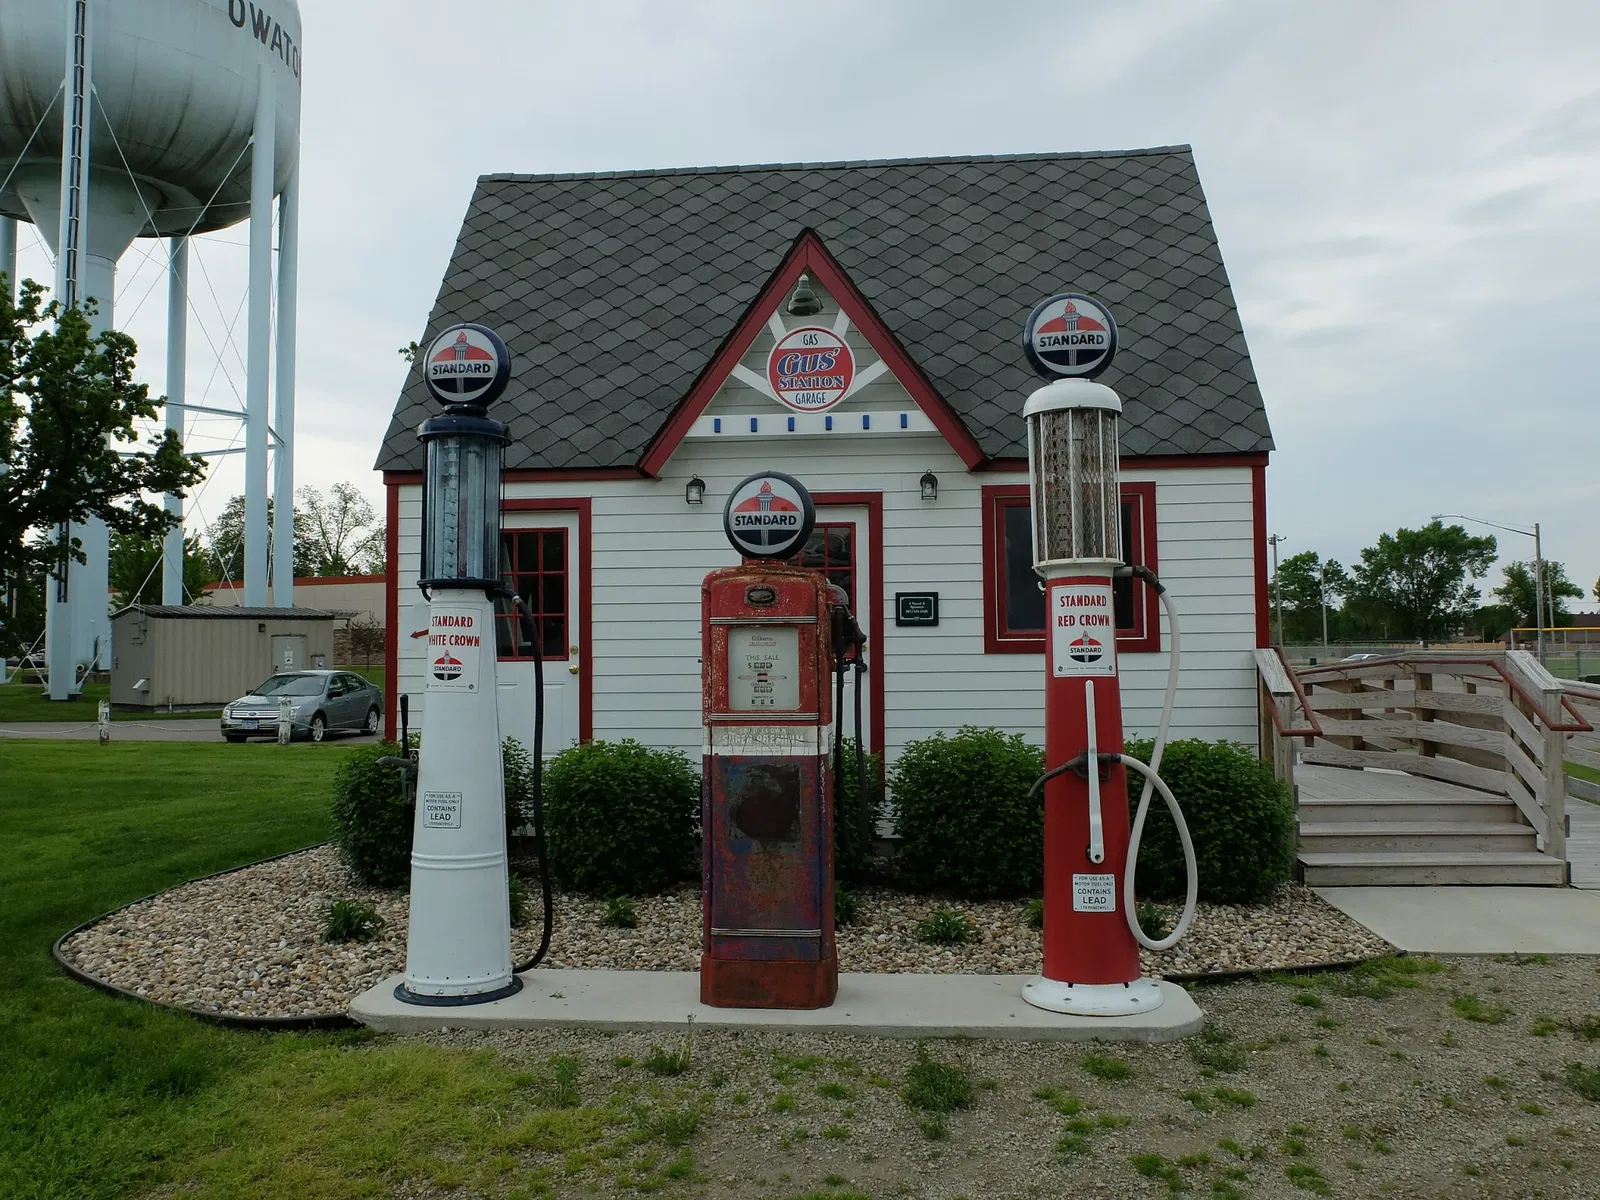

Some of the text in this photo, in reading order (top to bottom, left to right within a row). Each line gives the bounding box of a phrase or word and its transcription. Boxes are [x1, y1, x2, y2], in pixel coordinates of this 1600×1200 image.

[229, 0, 301, 86] OWATO
[803, 334, 818, 346] GAS
[1039, 334, 1104, 347] STANDARD
[432, 363, 491, 375] STANDARD
[779, 376, 844, 389] STATION
[795, 392, 826, 404] GARAGE
[735, 515, 797, 526] STANDARD
[1060, 595, 1106, 607] STANDARD
[431, 615, 474, 628] STANDARD
[1058, 614, 1110, 627] RED CROWN
[449, 635, 480, 647] CROWN
